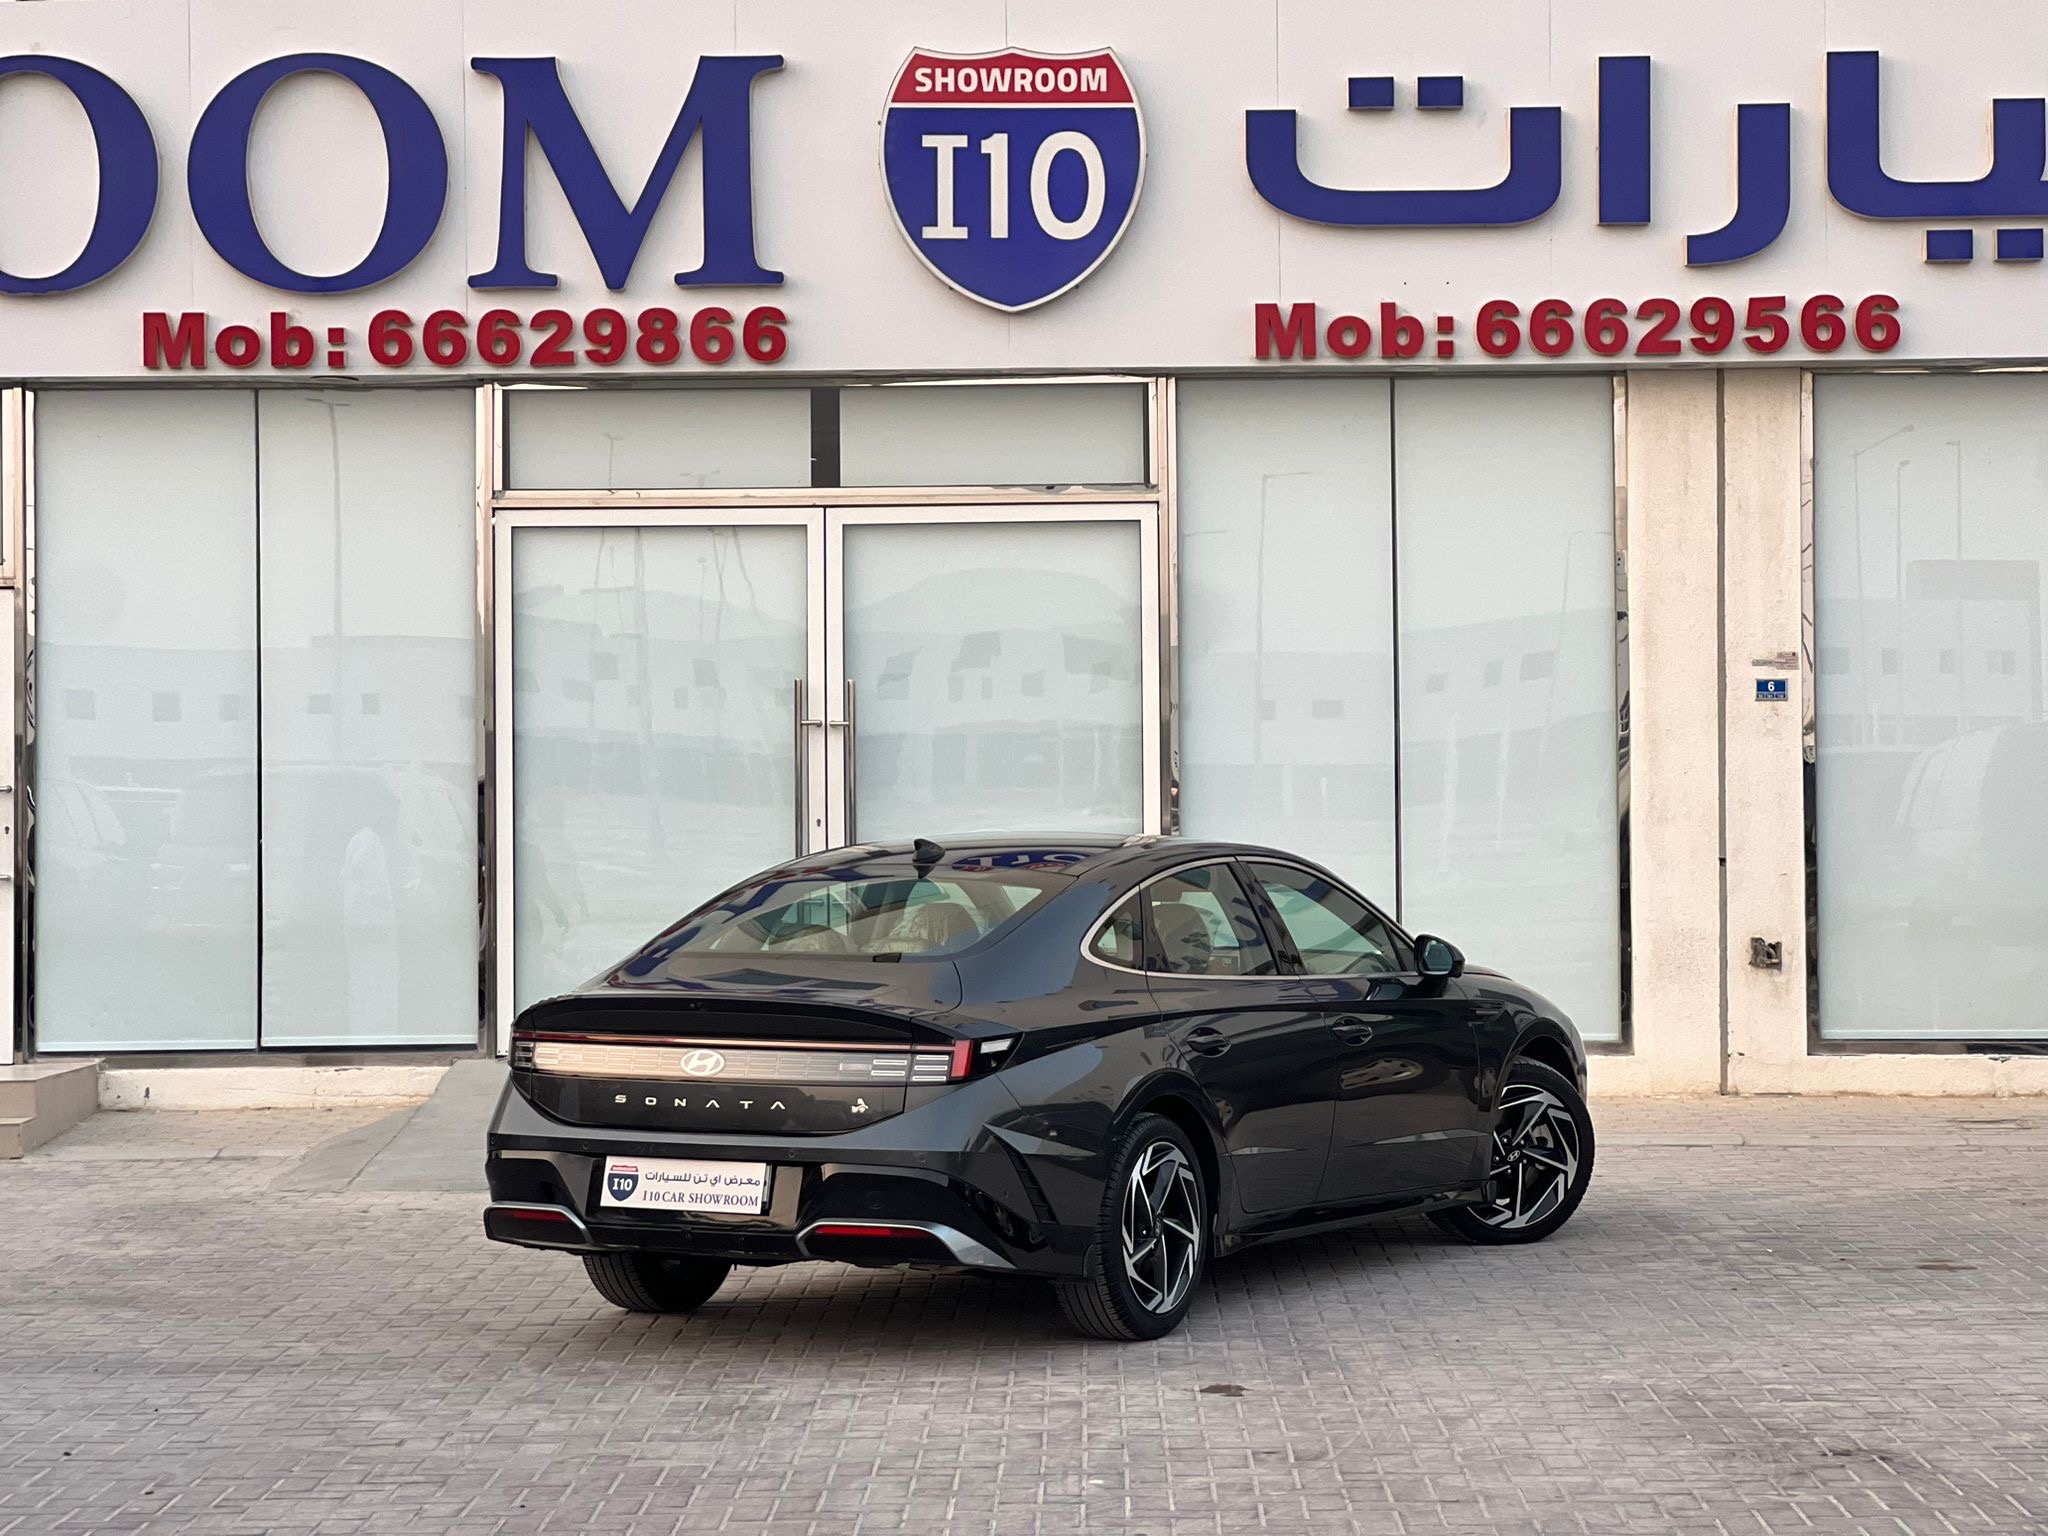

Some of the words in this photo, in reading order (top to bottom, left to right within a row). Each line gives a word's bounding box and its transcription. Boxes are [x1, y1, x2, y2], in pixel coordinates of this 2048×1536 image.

[914, 66, 1108, 93] SHOWROOM
[920, 131, 1107, 240] I10
[1474, 294, 1902, 357] 66629566
[366, 306, 788, 367] 66629866
[1767, 681, 1775, 692] 6
[614, 1094, 786, 1110] SONATA
[612, 1177, 634, 1191] I10
[645, 1171, 692, 1183] للسيارات
[724, 1174, 761, 1187] معرض
[687, 1192, 759, 1207] SHOWROOM
